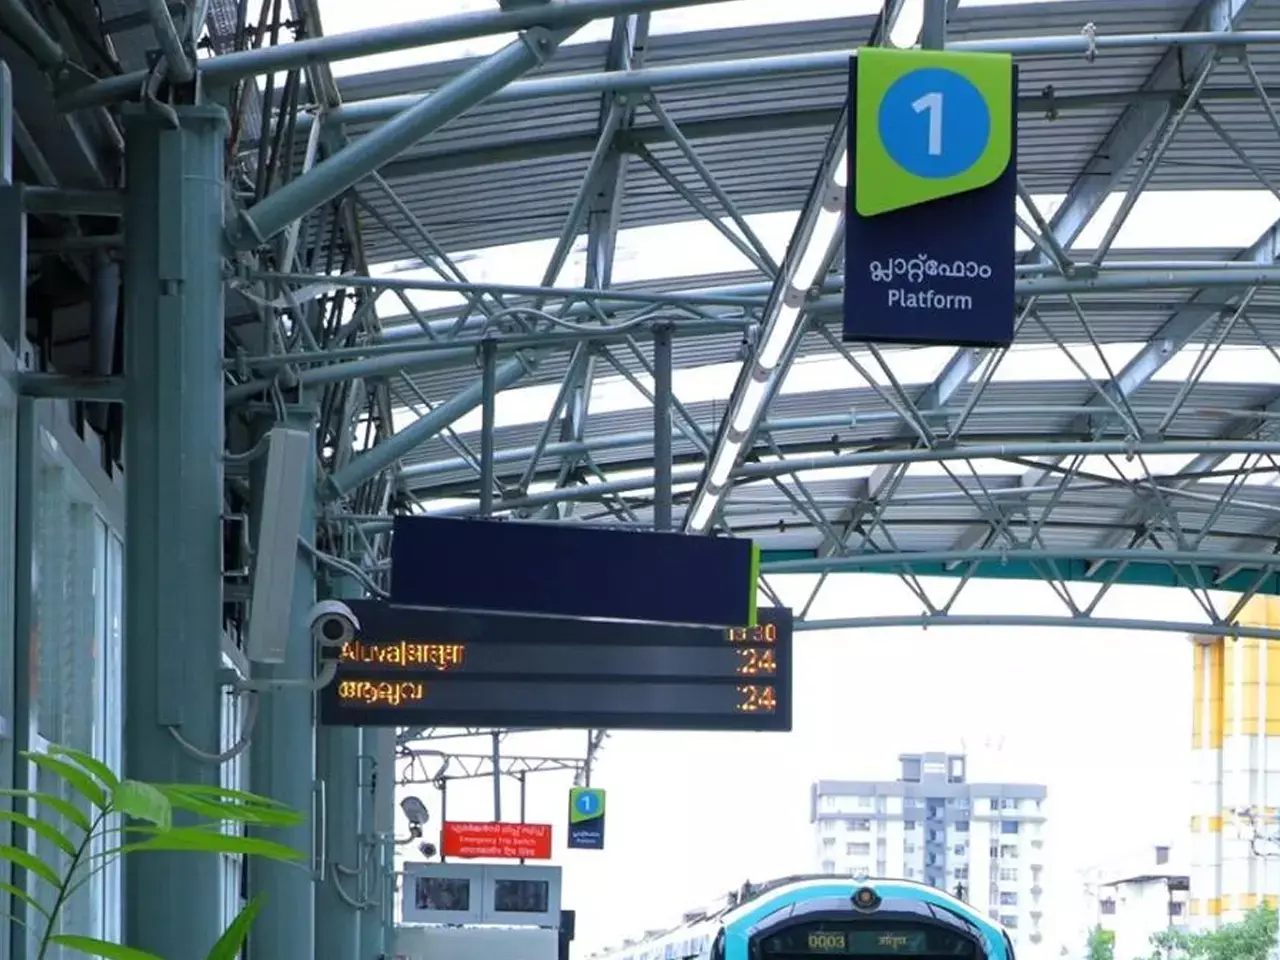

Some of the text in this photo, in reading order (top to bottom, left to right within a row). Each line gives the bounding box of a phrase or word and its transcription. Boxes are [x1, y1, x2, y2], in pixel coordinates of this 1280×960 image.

[911, 92, 944, 156] 1
[888, 289, 973, 310] Platform
[581, 795, 590, 811] 1
[808, 934, 845, 949] 0003
